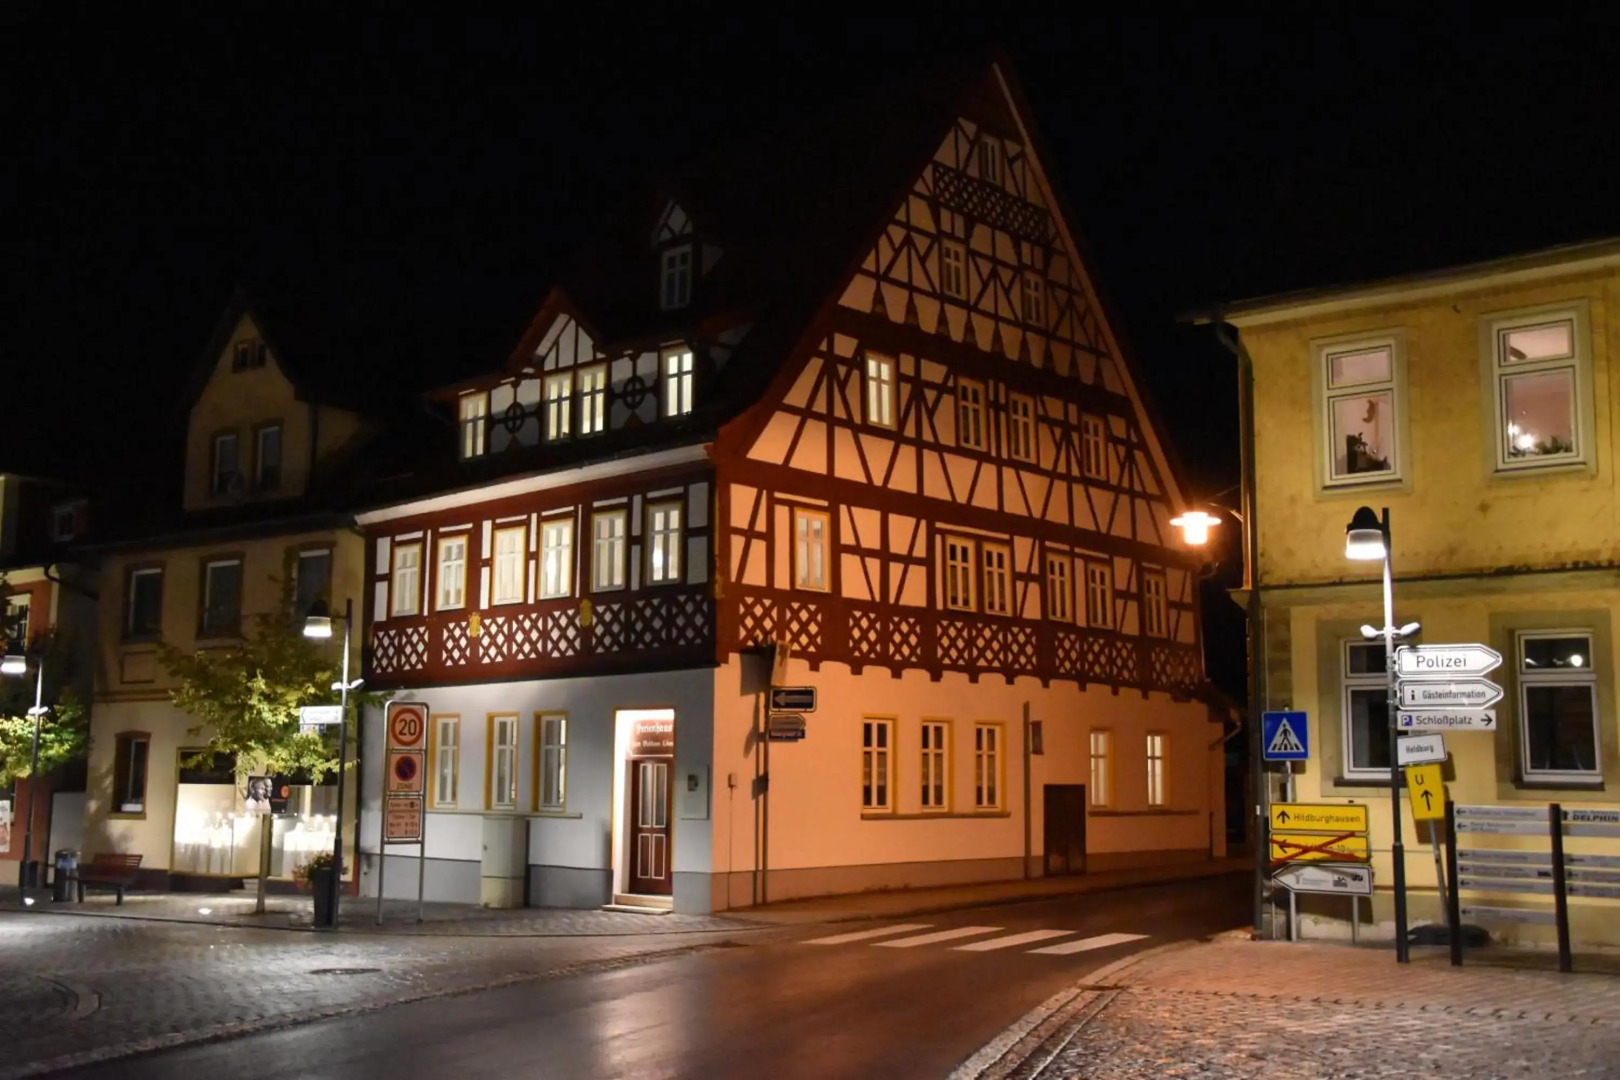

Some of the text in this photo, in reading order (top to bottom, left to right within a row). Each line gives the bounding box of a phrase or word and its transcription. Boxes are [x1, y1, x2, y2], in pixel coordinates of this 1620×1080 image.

[1416, 654, 1467, 668] Polizei
[1422, 689, 1486, 699] Gästeinformation
[1415, 715, 1473, 726] Schloßplatz
[398, 718, 417, 736] 20
[1414, 774, 1425, 786] U
[1293, 813, 1361, 824] Hildburghausen
[1572, 813, 1620, 822] DELPHIN
